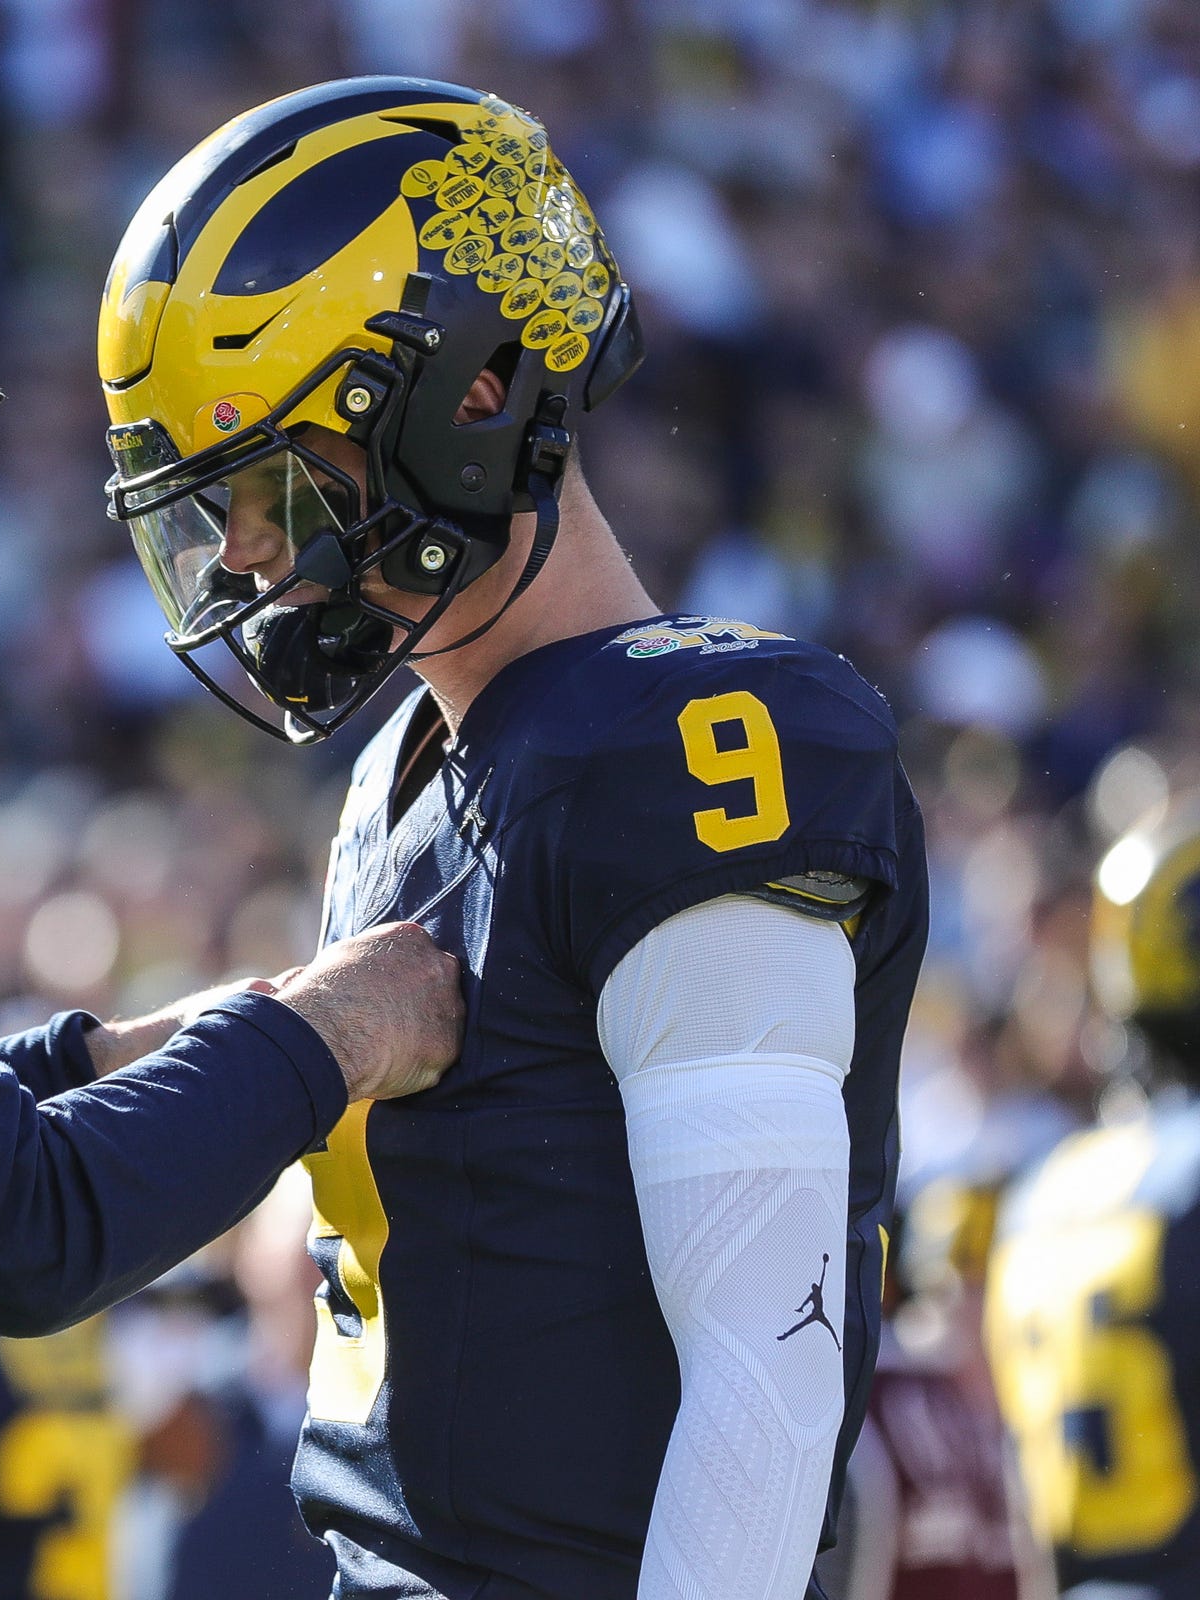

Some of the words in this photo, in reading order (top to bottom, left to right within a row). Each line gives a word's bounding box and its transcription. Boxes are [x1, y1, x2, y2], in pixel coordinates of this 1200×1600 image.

[444, 182, 480, 207] VICTORY
[552, 341, 584, 368] VICTORY
[677, 690, 791, 853] 9
